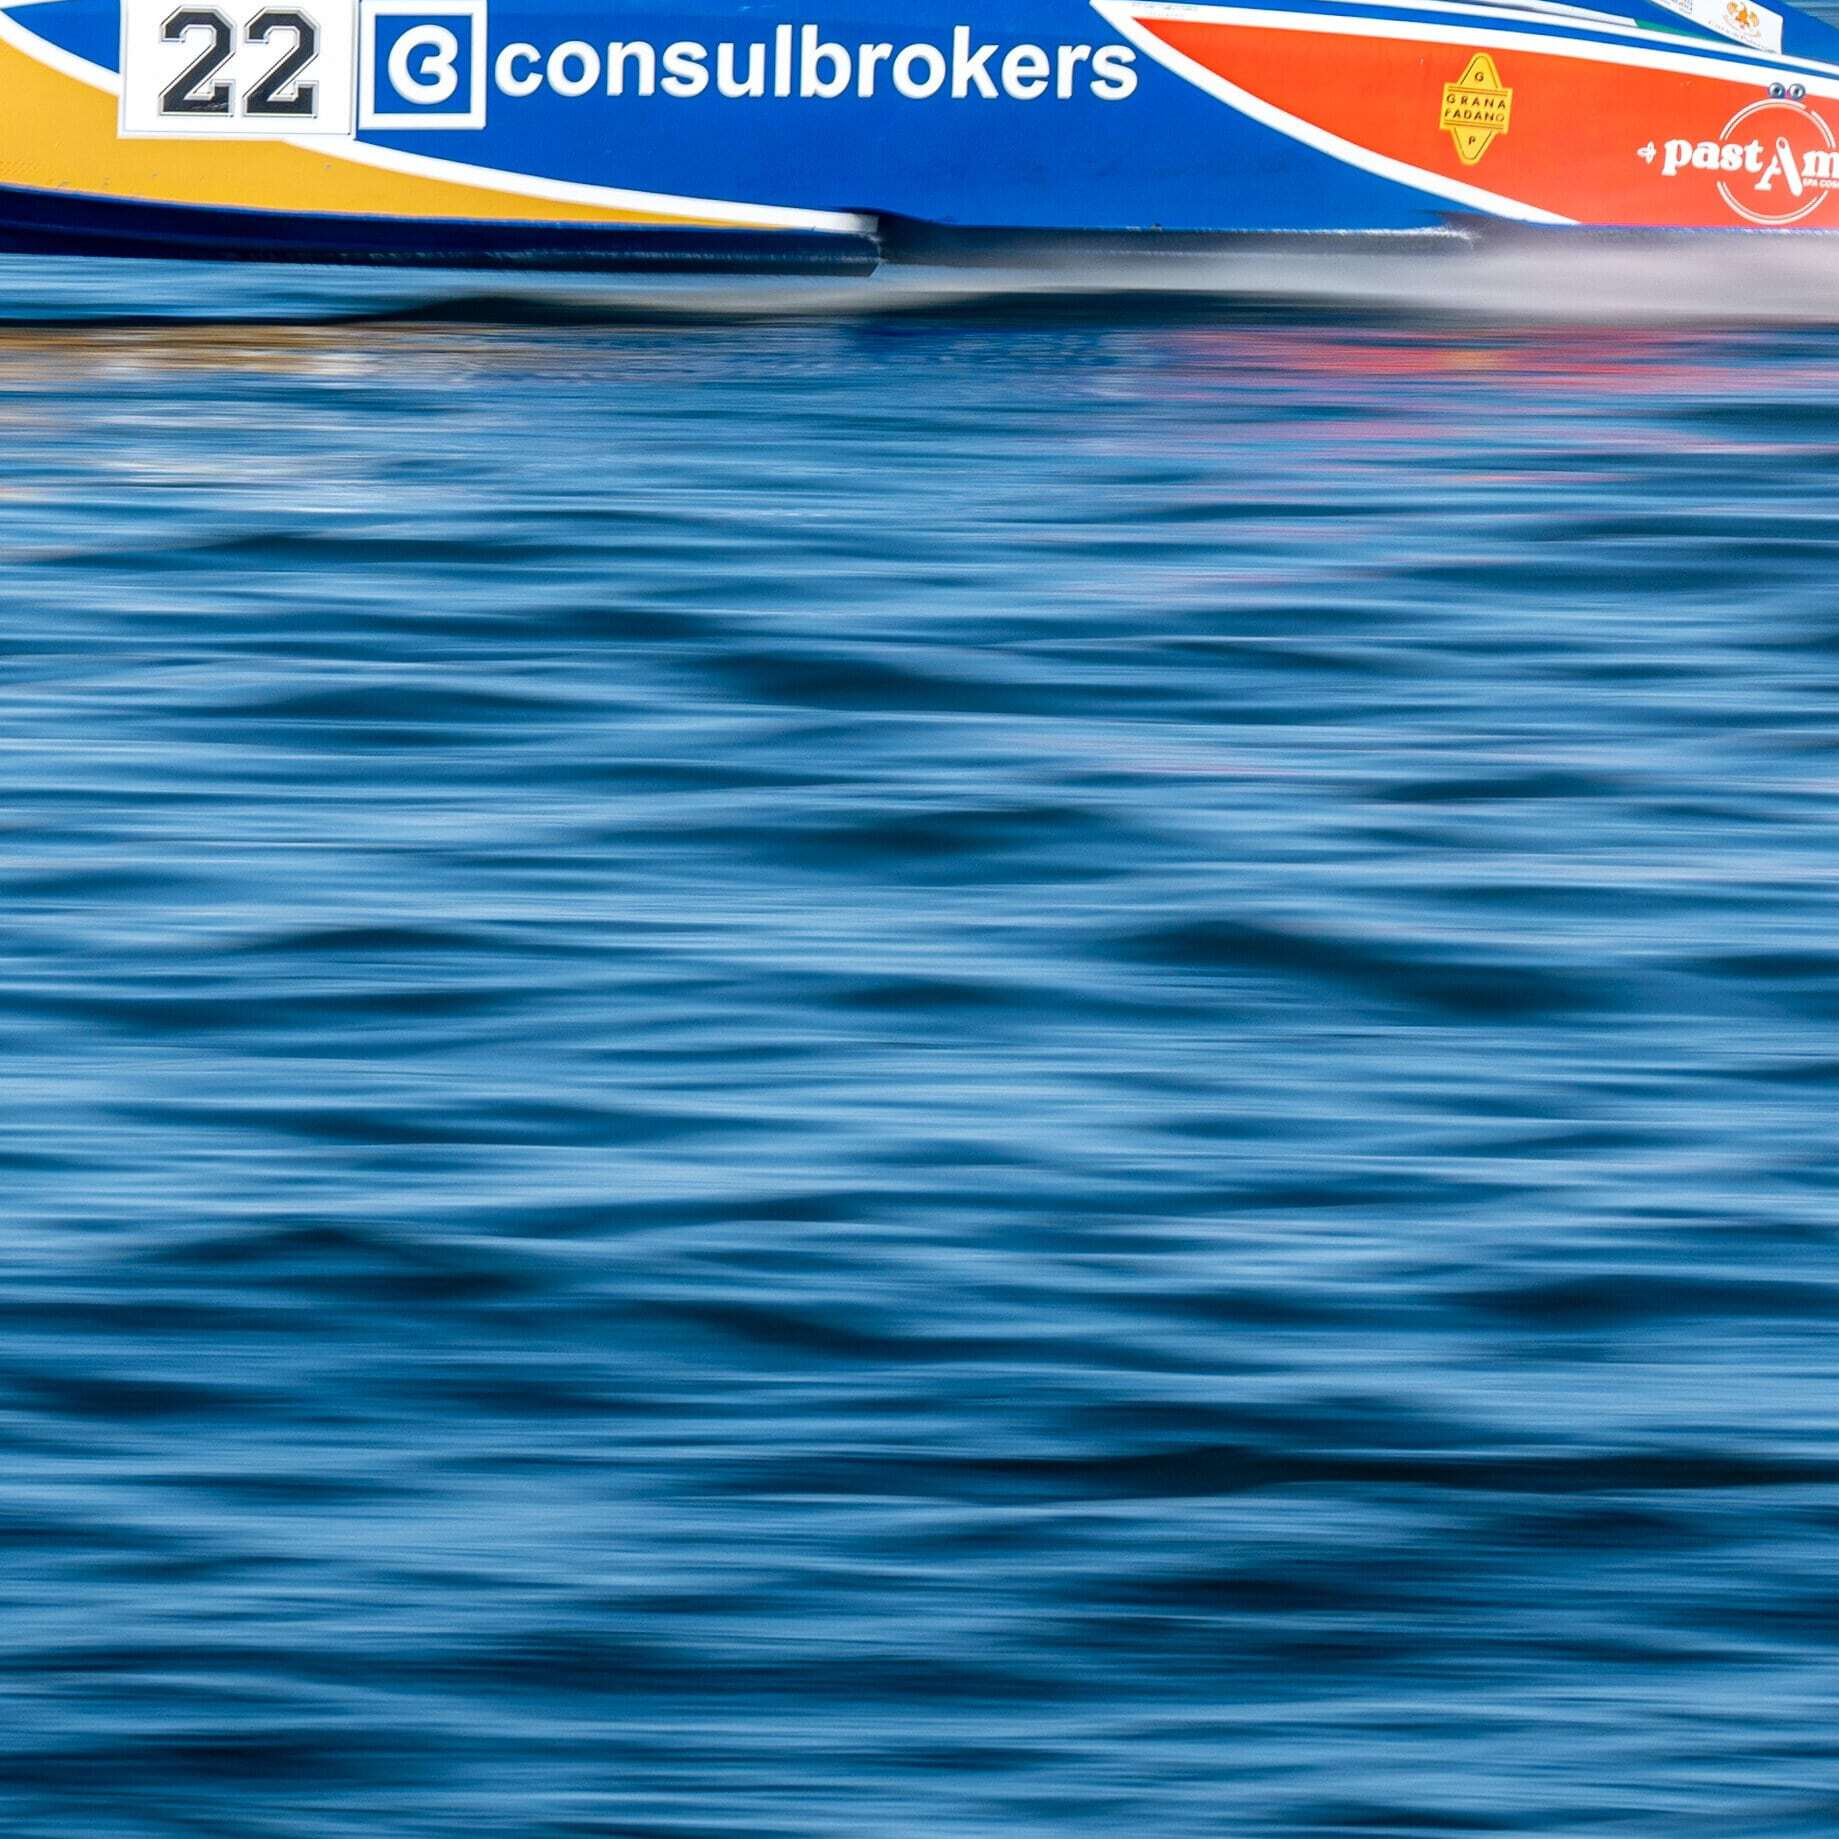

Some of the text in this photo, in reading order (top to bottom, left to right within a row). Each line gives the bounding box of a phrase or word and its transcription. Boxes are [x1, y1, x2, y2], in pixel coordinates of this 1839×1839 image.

[160, 6, 319, 117] 22
[495, 24, 1138, 100] consulbrokers
[1474, 71, 1484, 82] G
[1446, 93, 1506, 109] GRANA
[1444, 109, 1505, 123] PADANO
[1468, 136, 1476, 145] P
